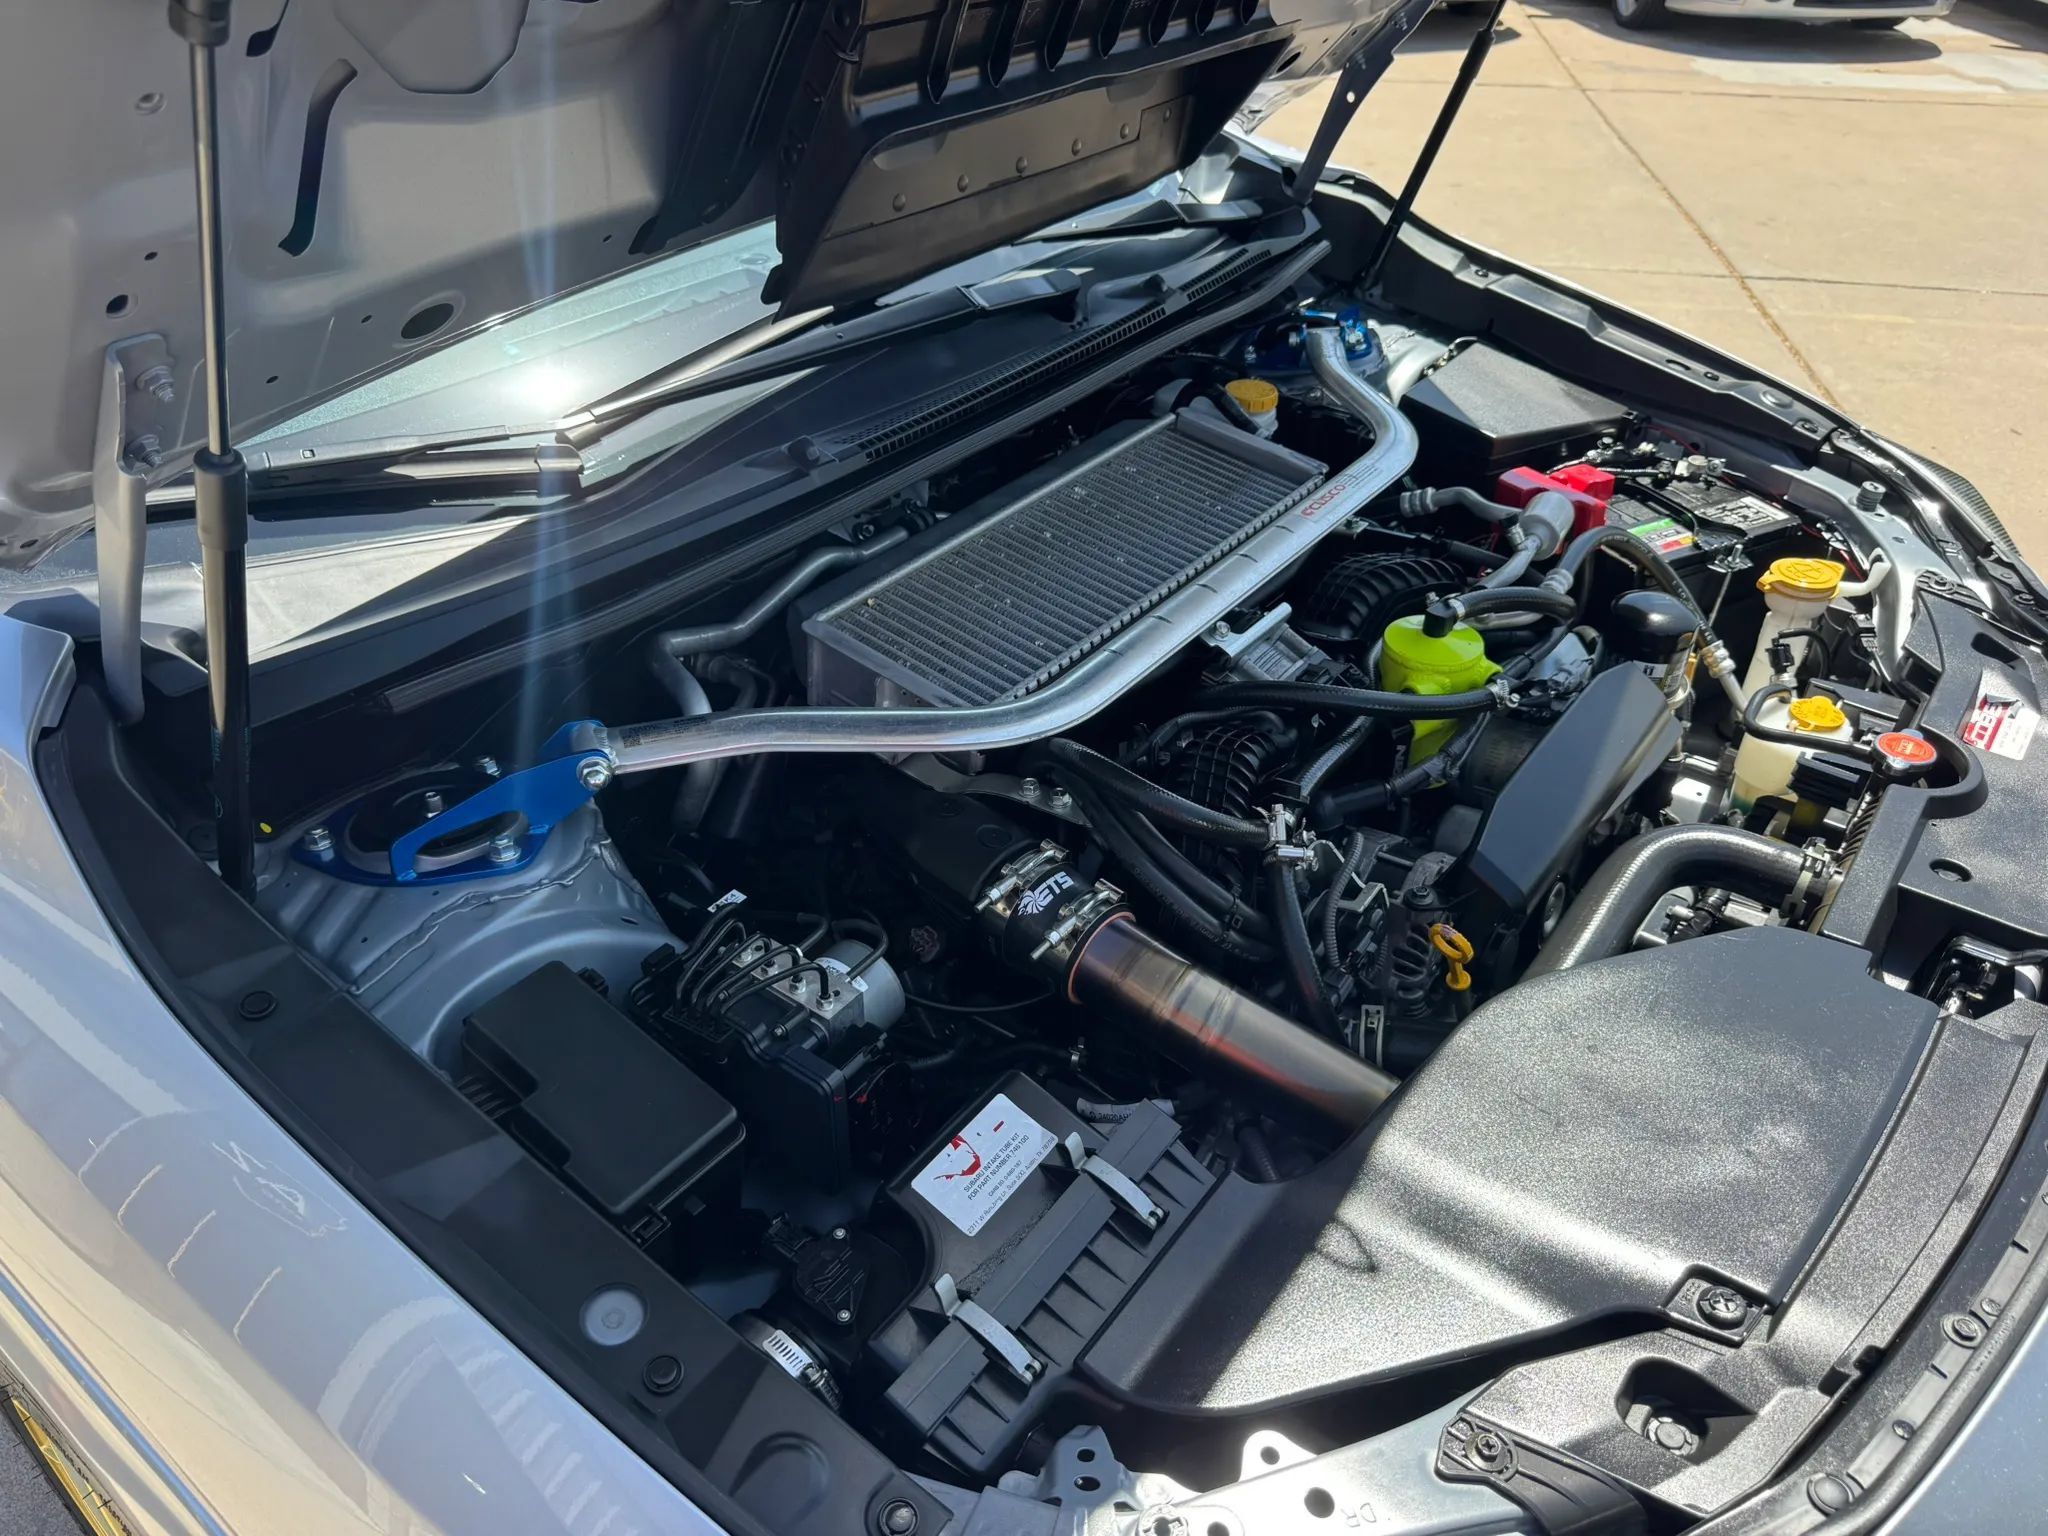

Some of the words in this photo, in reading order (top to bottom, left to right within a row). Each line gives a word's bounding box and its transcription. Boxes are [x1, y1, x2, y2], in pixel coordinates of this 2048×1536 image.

[1034, 871, 1075, 907] ETS
[963, 1169, 985, 1193] SUBARU
[982, 1151, 1001, 1172] INTAKE
[999, 1139, 1013, 1155] TUBE
[1010, 1132, 1020, 1142] KIT
[967, 1187, 980, 1200] FOR
[977, 1174, 992, 1190] PART
[989, 1152, 1011, 1176] NUMBER
